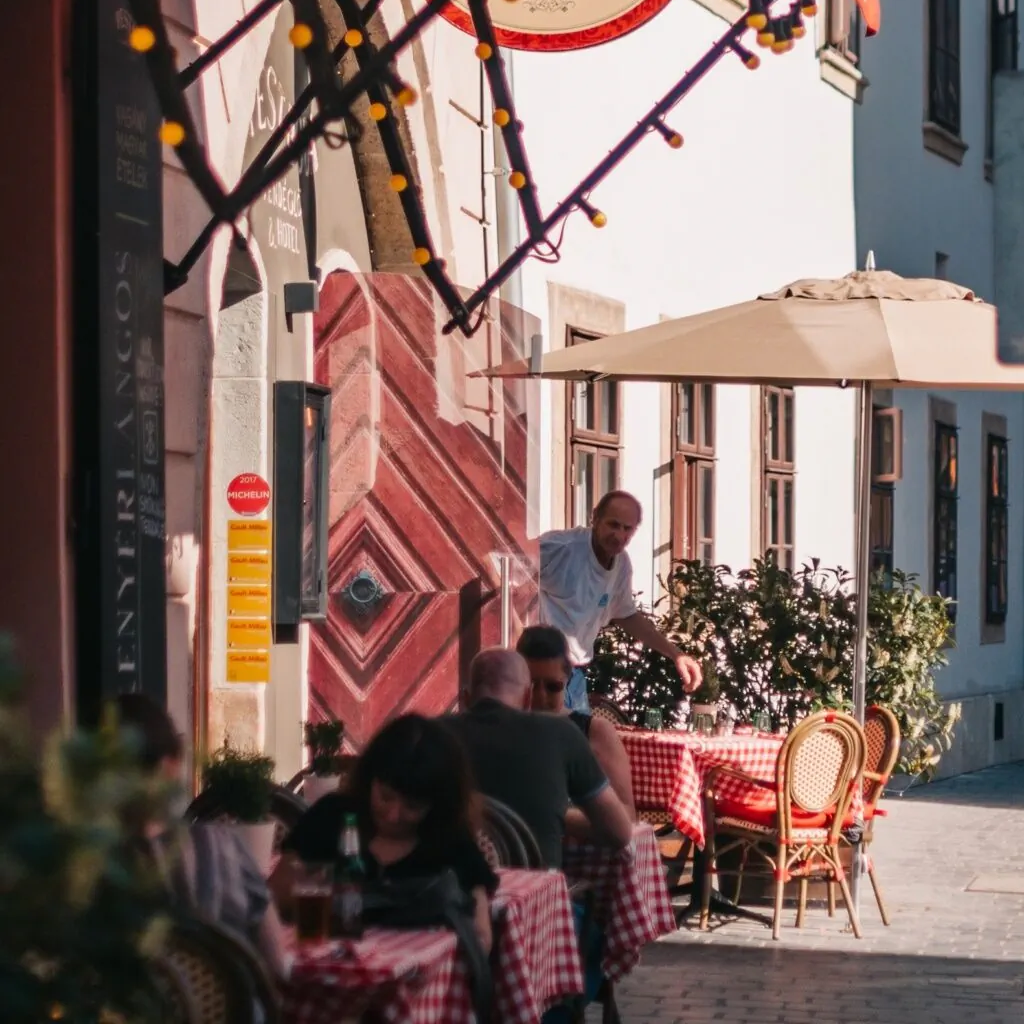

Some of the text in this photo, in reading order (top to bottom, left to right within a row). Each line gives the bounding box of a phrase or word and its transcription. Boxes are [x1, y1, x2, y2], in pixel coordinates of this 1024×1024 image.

[277, 217, 300, 254] HOTEL
[239, 476, 257, 484] 2017
[227, 491, 270, 499] MICHELIN
